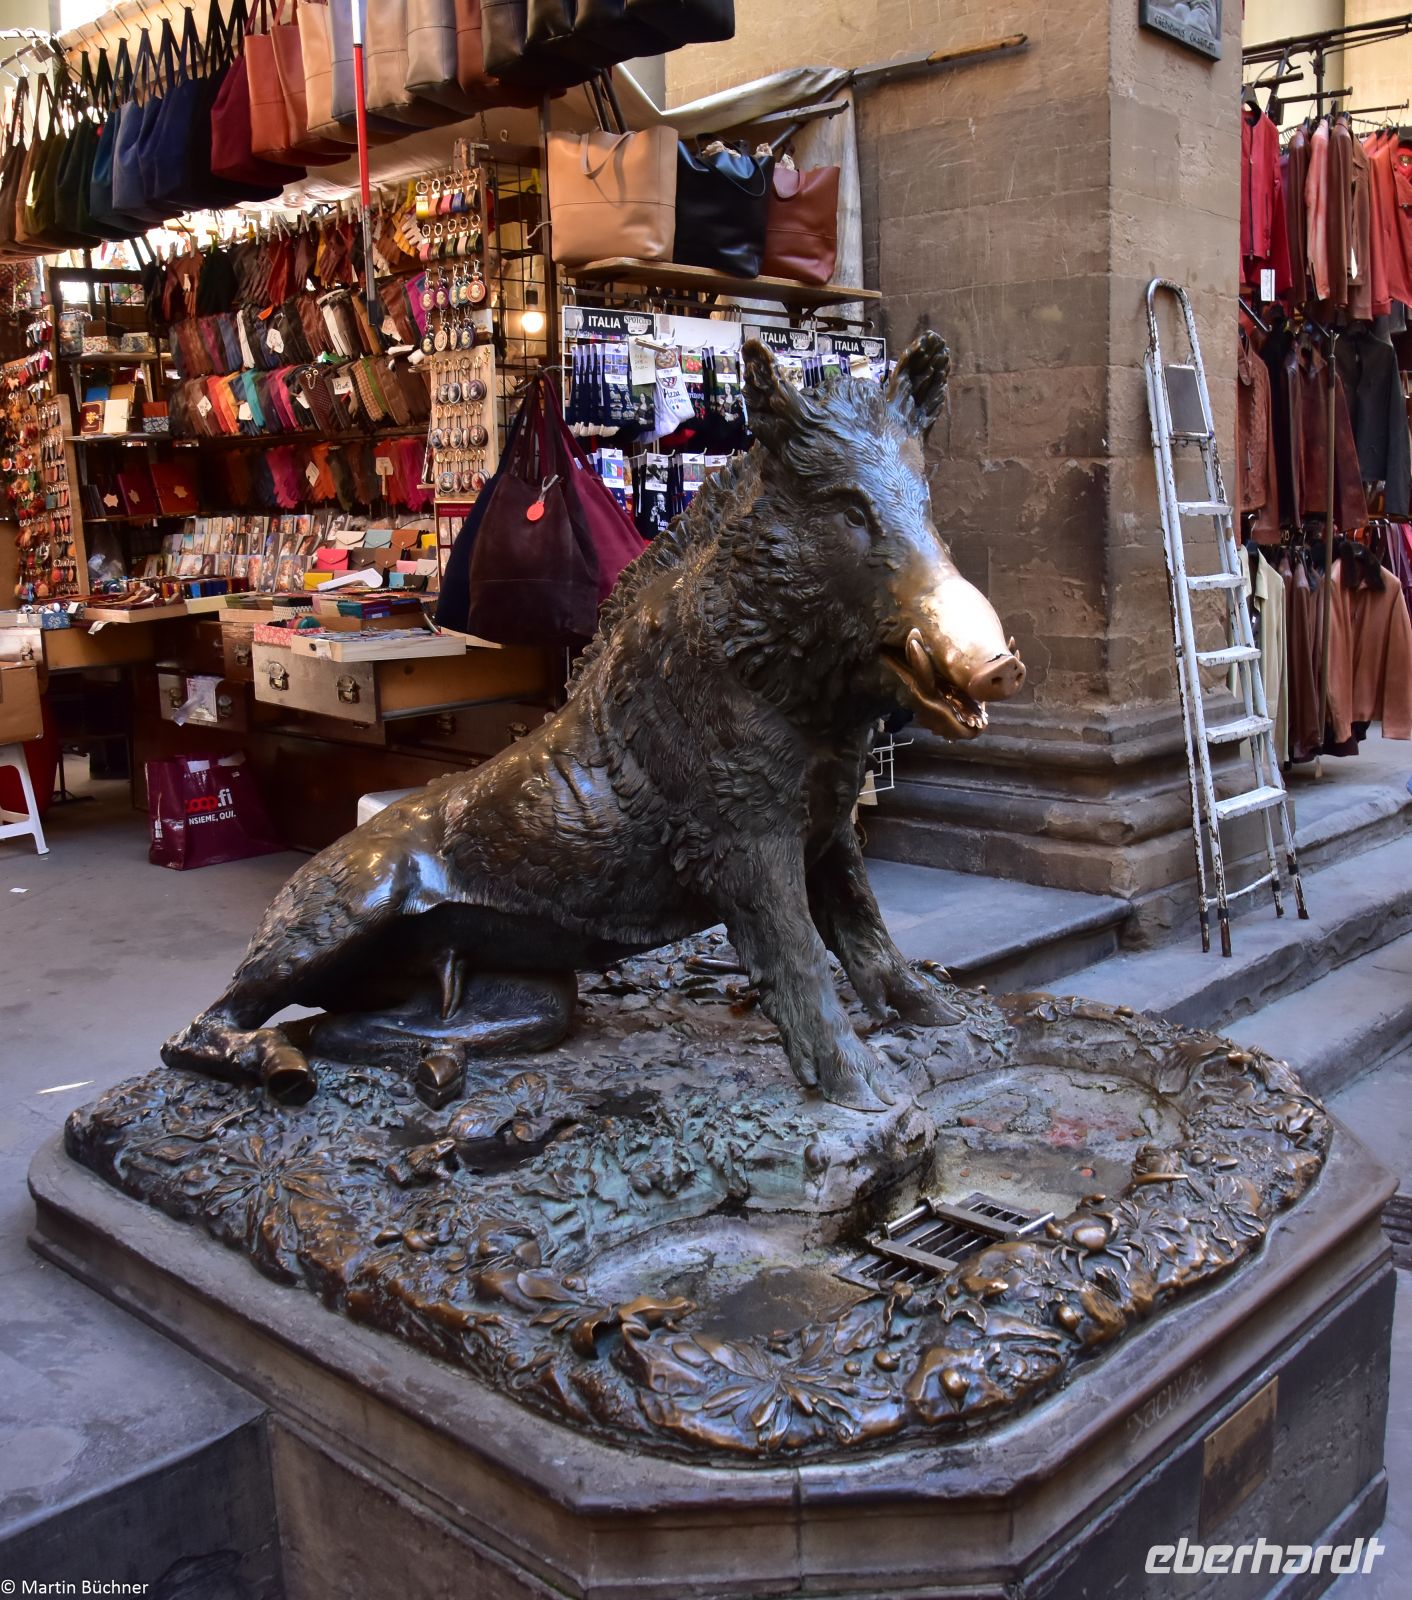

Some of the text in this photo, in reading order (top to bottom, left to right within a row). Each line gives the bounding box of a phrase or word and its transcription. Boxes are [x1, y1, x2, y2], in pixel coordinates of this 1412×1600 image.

[588, 315, 621, 329] ITALIA
[760, 331, 788, 344] ITALIA
[834, 340, 860, 352] ITALIA
[188, 810, 237, 825] NSIEME, QUI.
